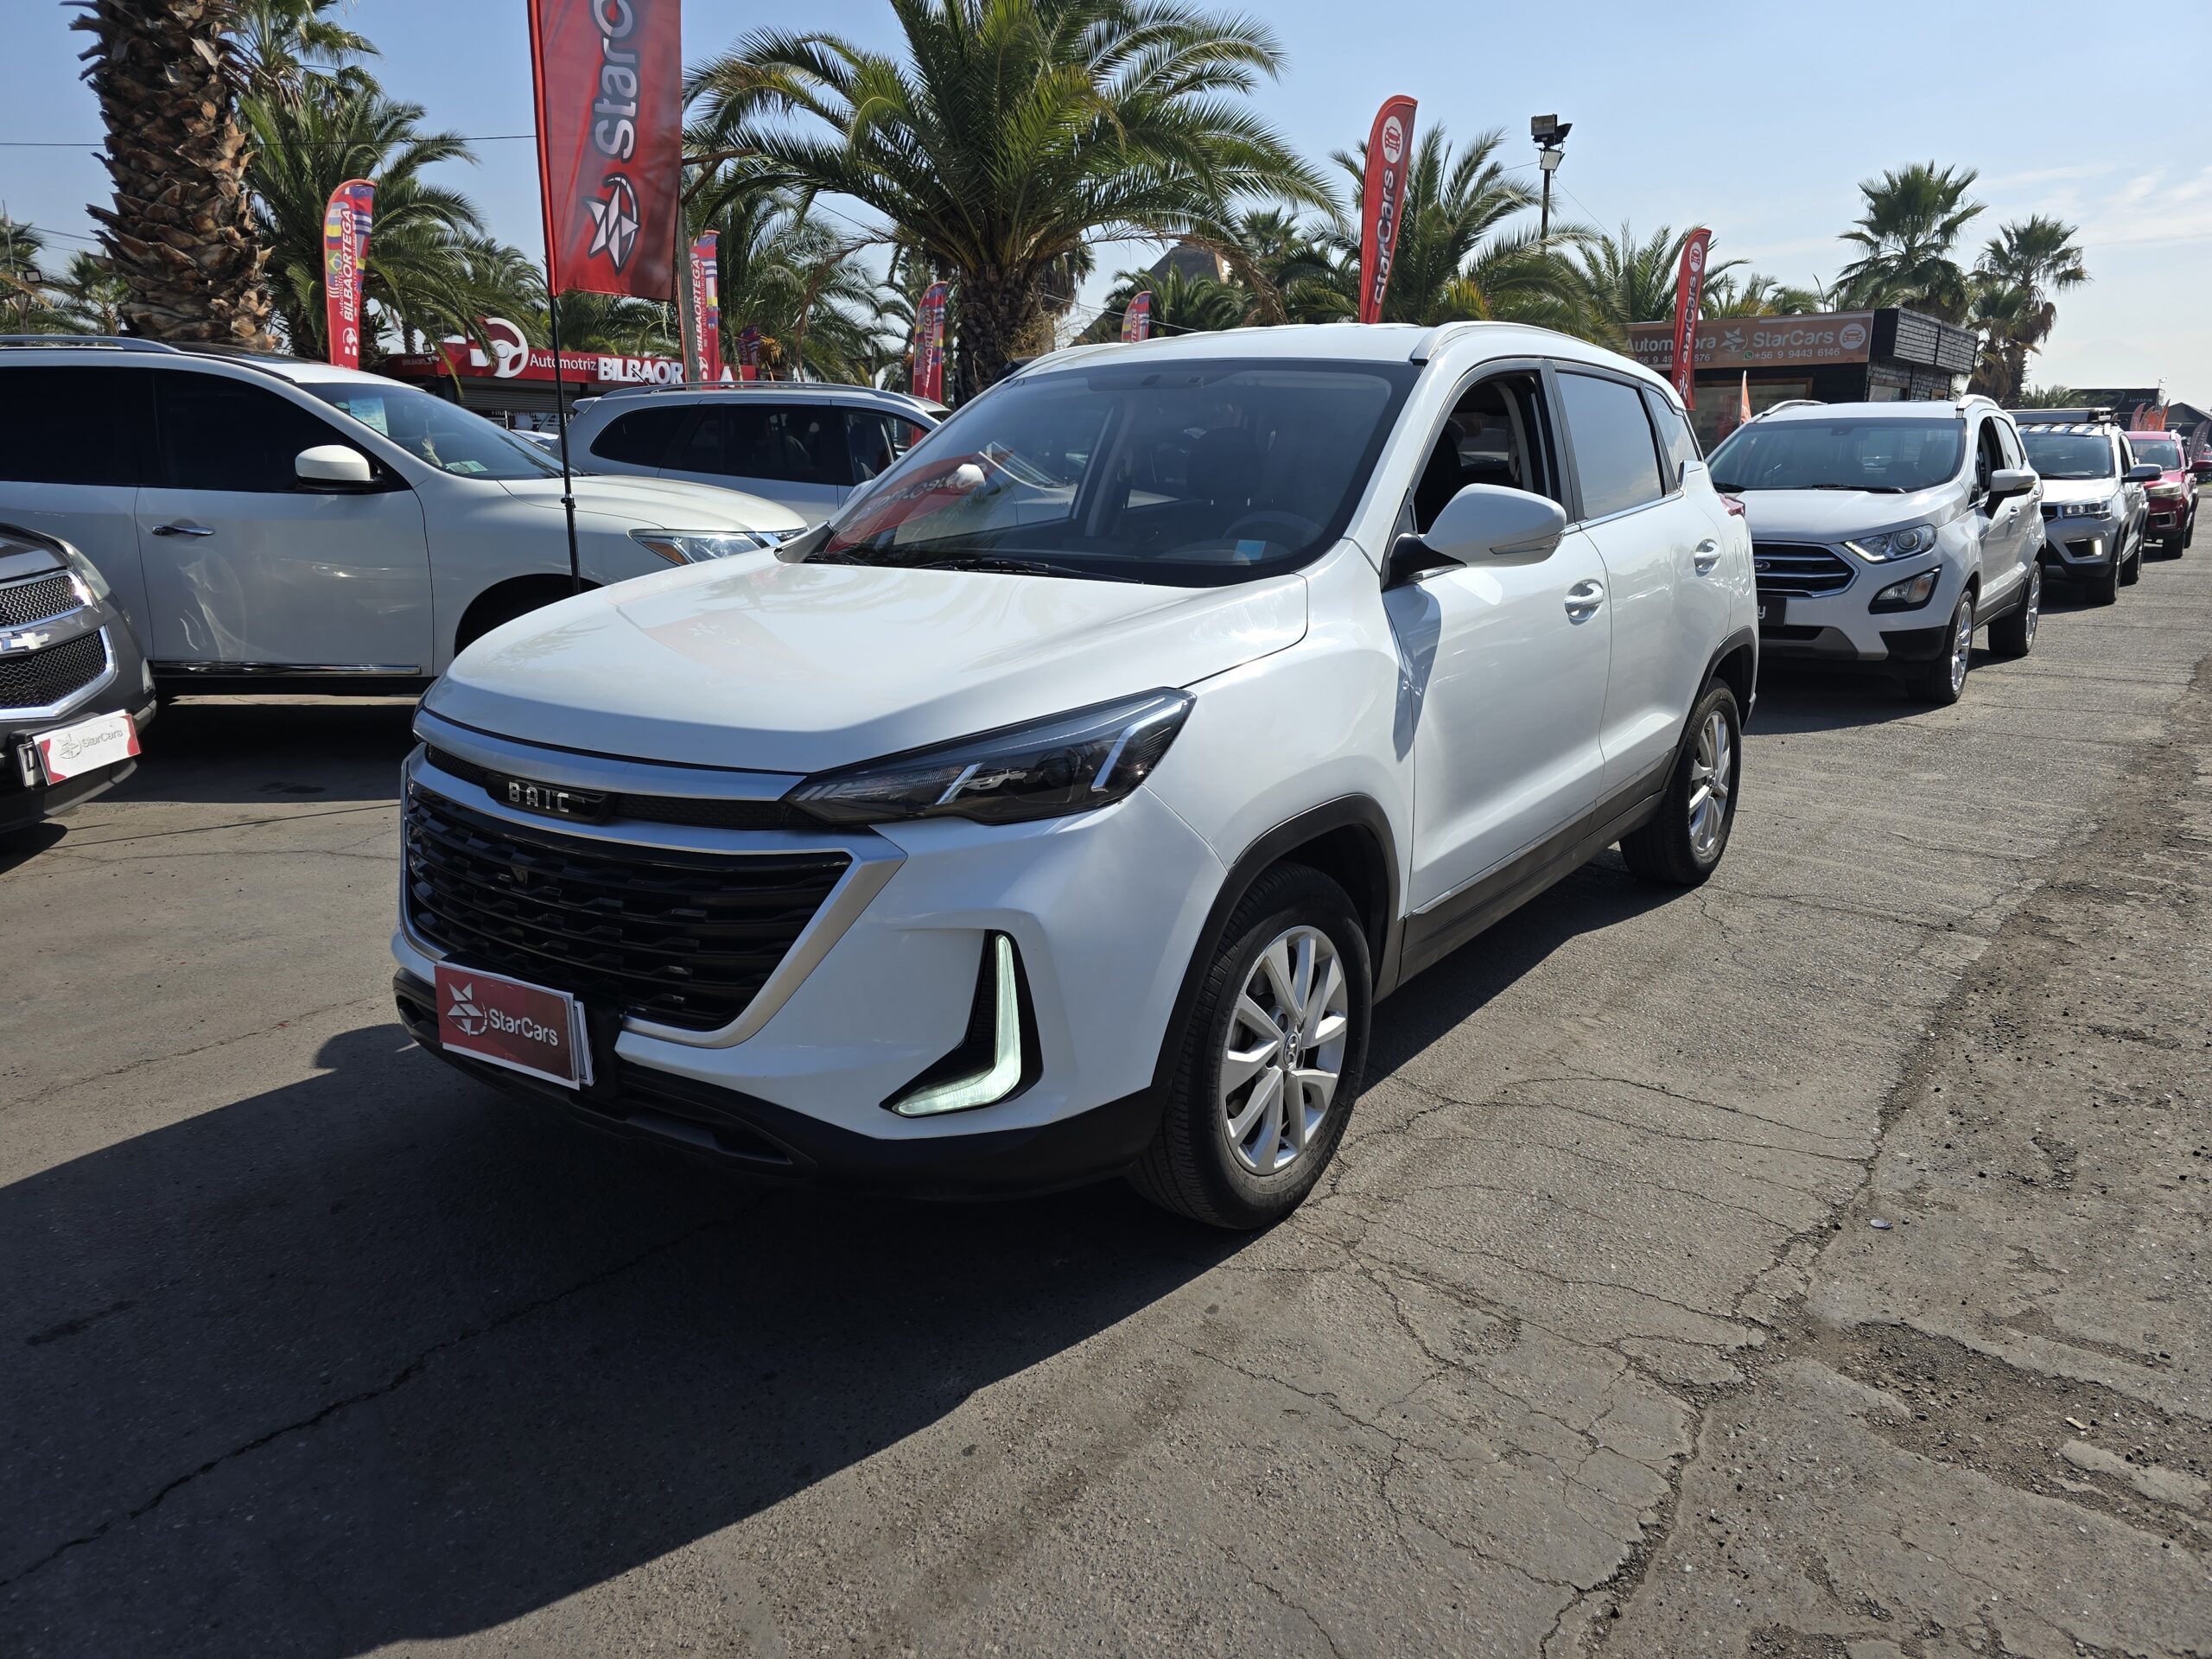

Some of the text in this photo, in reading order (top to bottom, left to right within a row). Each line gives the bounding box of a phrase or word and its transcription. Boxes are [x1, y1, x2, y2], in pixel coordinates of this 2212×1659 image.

[1374, 169, 1395, 304] StarCars
[341, 209, 353, 322] BILBAORTEGA
[692, 259, 703, 352] BILBAORTEGA
[1752, 329, 1834, 346] StarCars
[1755, 347, 1840, 360] +56 9 9443 6146
[81, 730, 123, 748] StarCars
[508, 781, 569, 813] BAIC
[489, 1007, 559, 1046] StarCars
